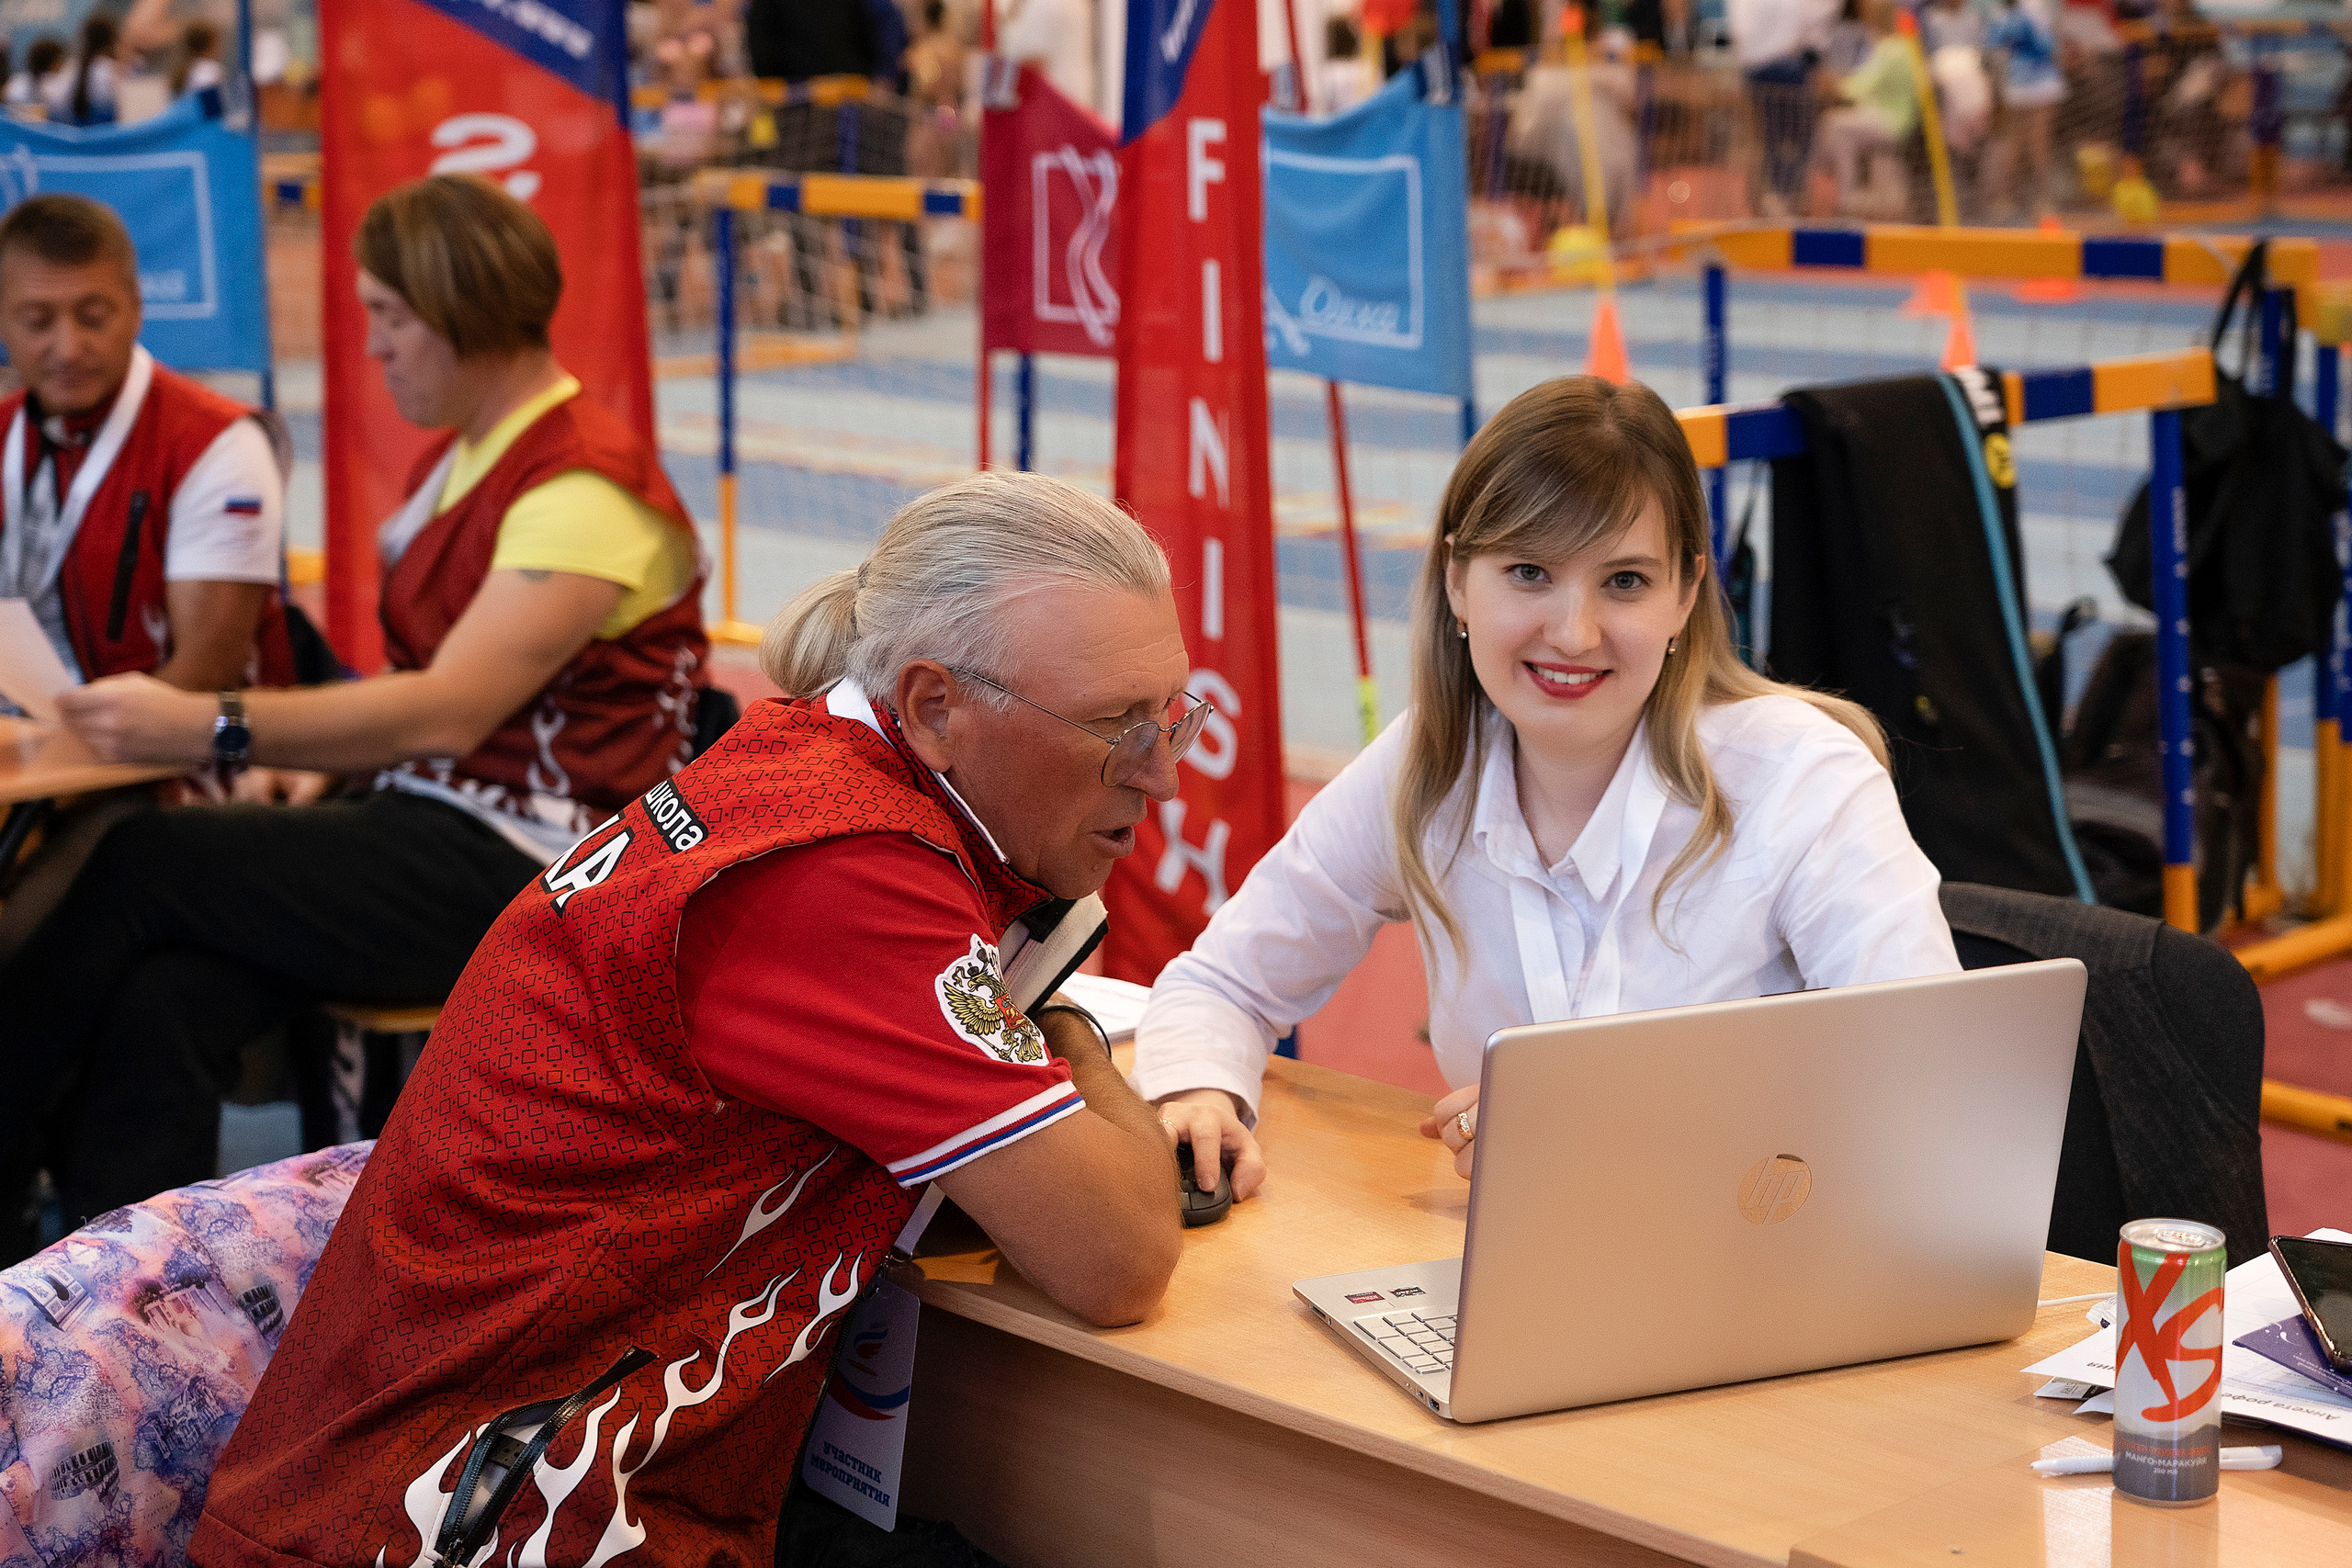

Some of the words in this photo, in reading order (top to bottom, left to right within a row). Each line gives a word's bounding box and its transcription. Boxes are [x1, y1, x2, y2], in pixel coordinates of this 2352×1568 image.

[1155, 117, 1242, 917] FINISH
[1741, 1155, 1809, 1225] hp
[2115, 1240, 2224, 1422] XS
[2273, 1402, 2341, 1421] Анкета
